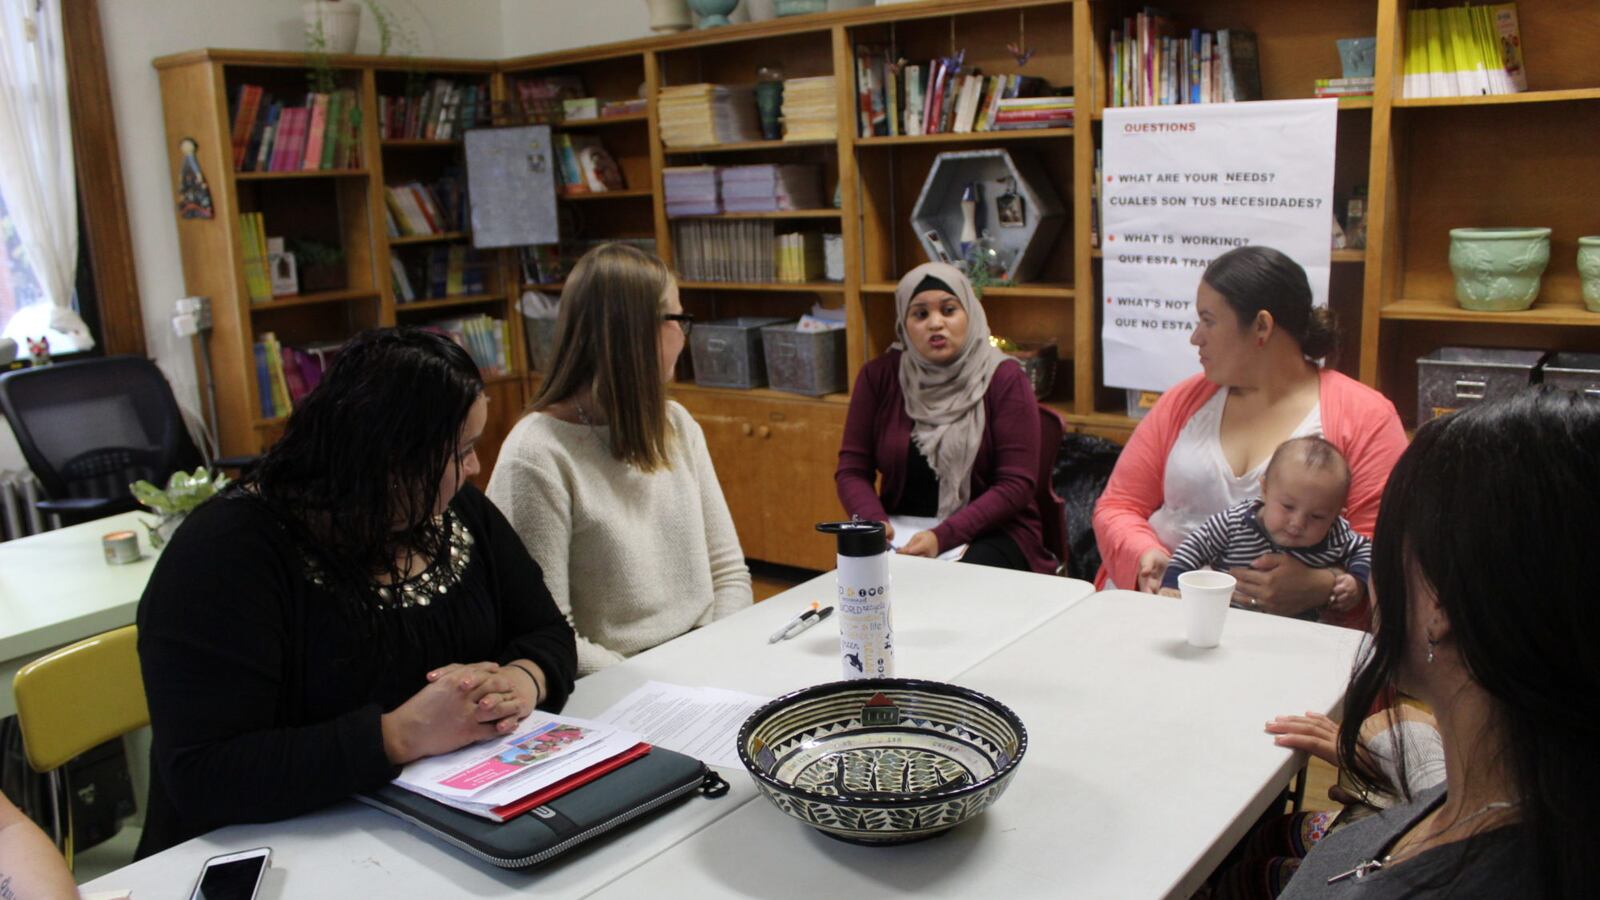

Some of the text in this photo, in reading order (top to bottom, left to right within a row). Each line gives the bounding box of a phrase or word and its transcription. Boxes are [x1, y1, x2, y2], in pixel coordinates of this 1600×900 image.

[1124, 122, 1196, 133] QUESTIONS
[1119, 172, 1276, 183] WHAT ARE YOUR NEEDS?
[1109, 196, 1323, 208] CUALES SON TUS NECESIDADES?
[1124, 234, 1250, 247] WHAT IS WORKING?
[1118, 254, 1143, 264] QUE
[1147, 255, 1178, 265] ESTA
[1117, 297, 1190, 310] WHAT'S NOT
[1115, 318, 1138, 328] QUE
[1141, 319, 1158, 329] NO
[1162, 320, 1193, 331] ESTA
